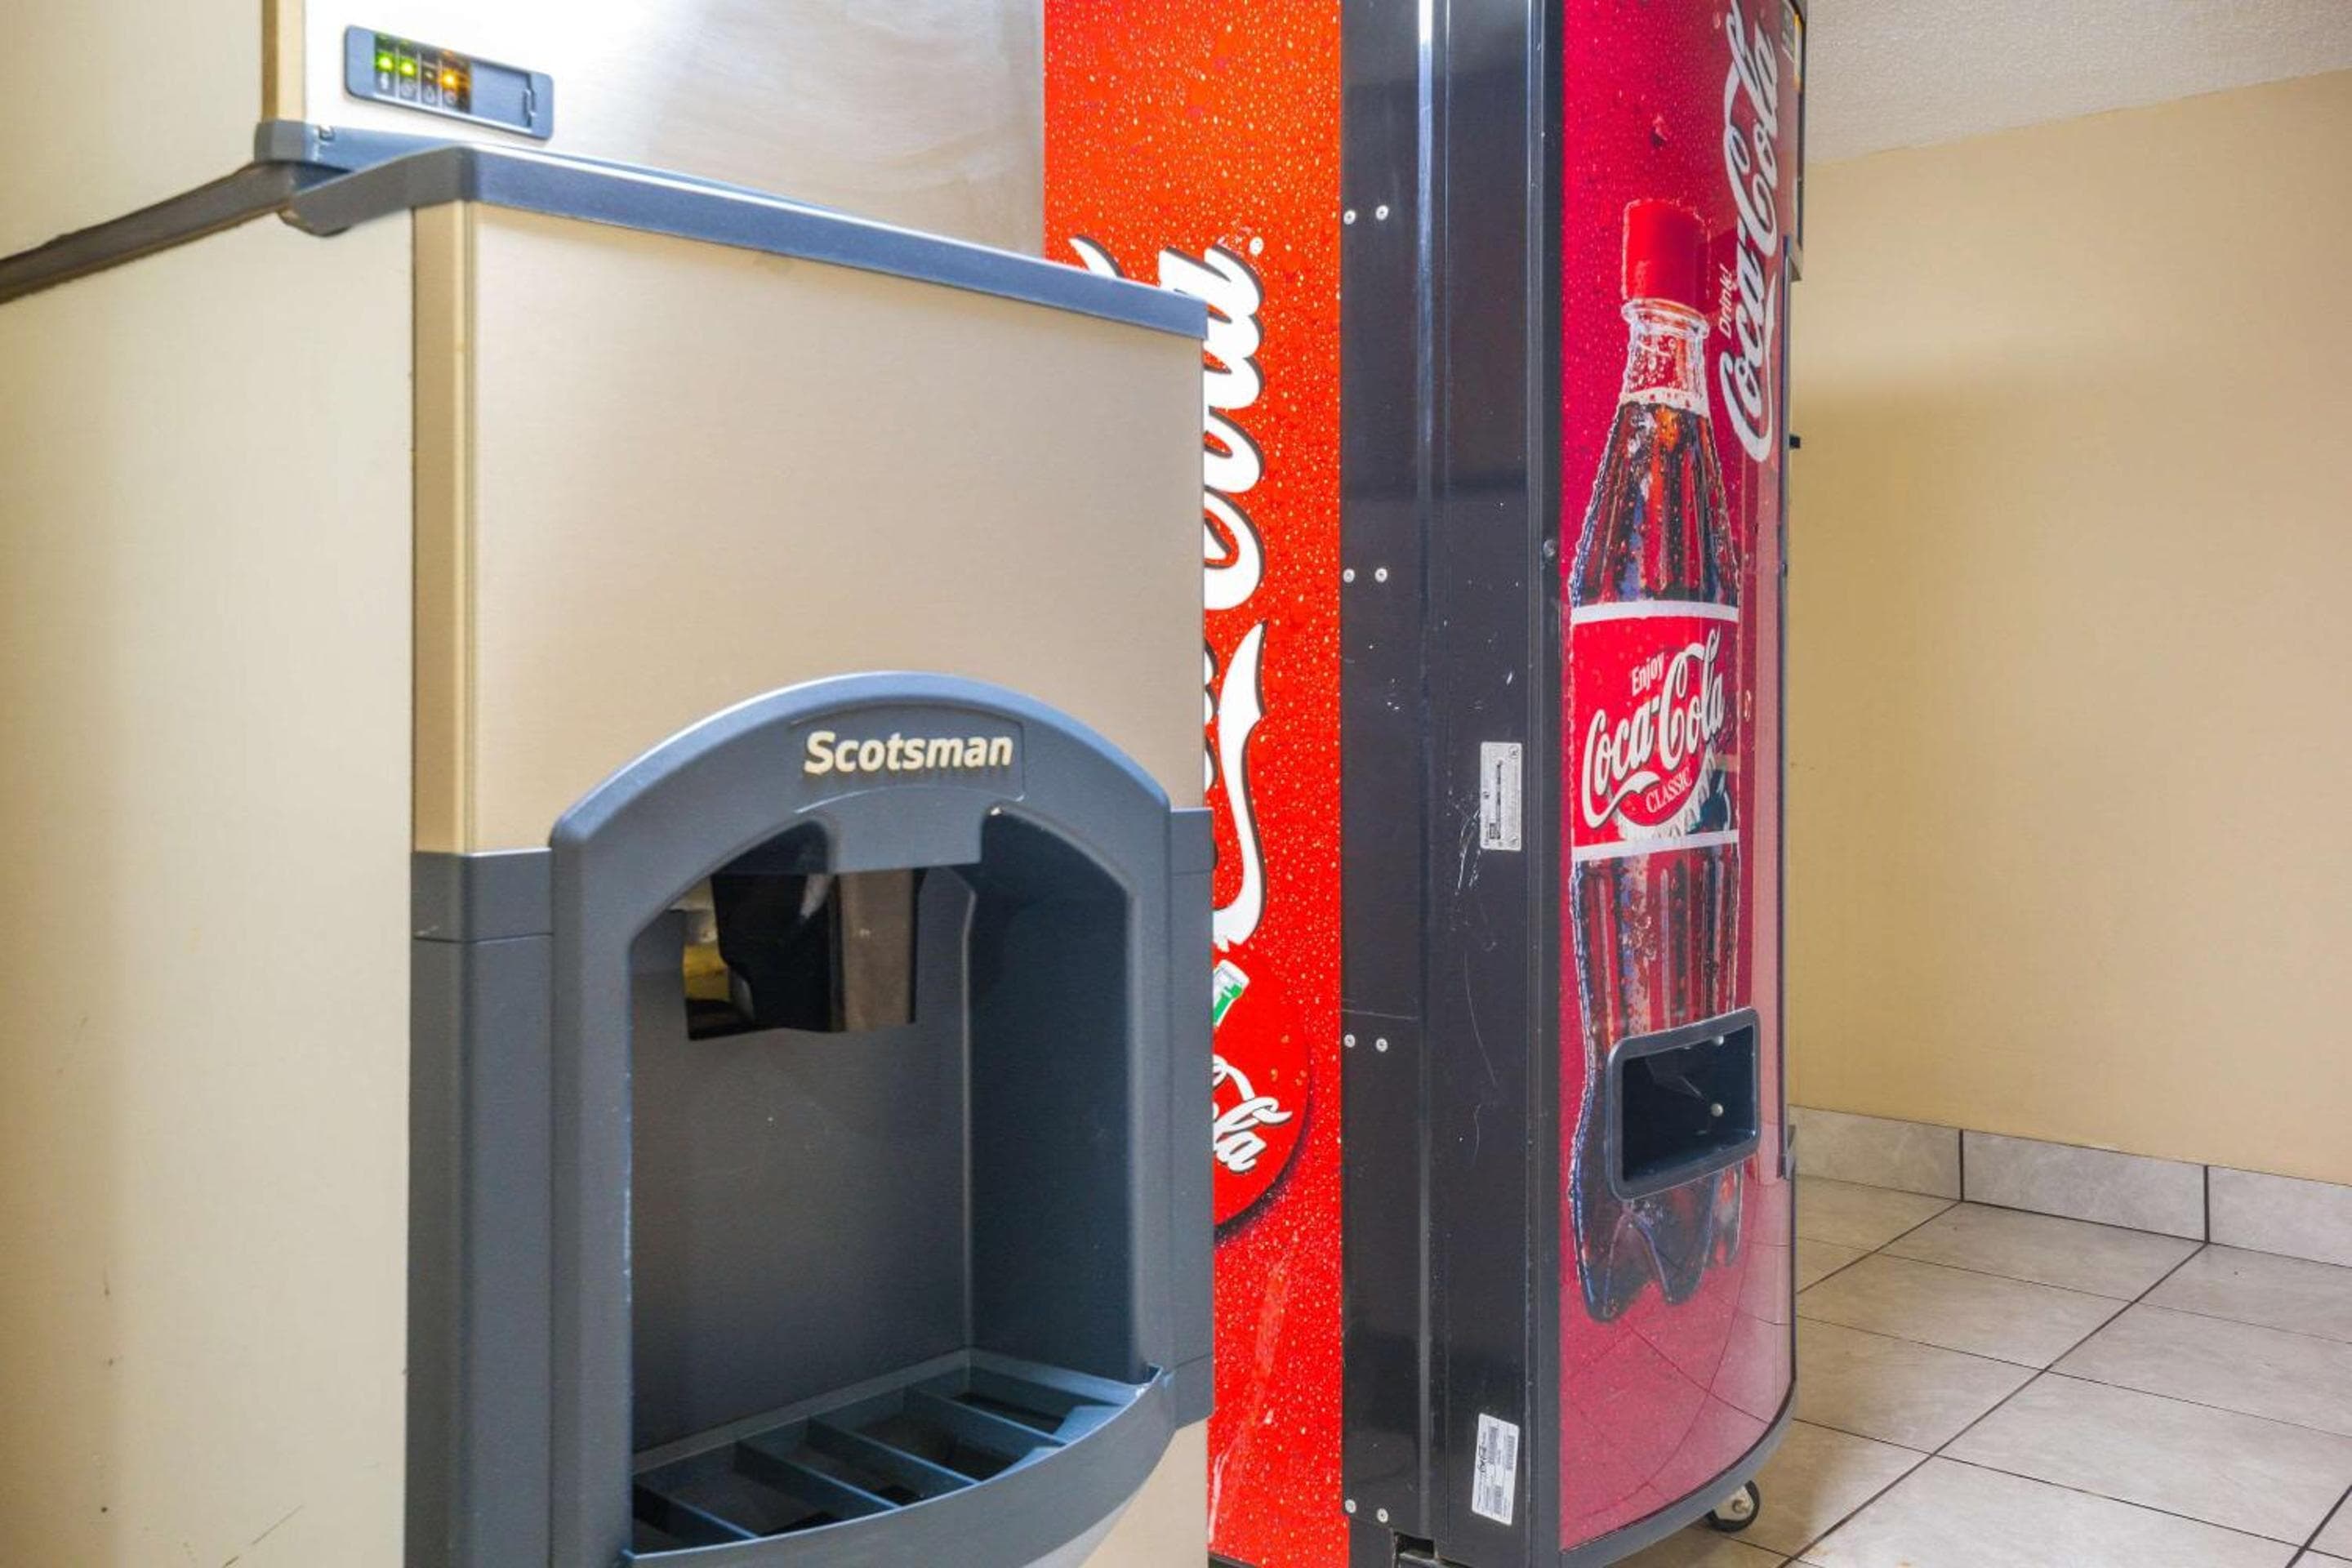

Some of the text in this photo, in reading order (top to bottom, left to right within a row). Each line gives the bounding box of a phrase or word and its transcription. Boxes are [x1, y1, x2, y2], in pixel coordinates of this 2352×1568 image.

[1632, 652, 1665, 697] Enjoy
[1582, 624, 1724, 829] Coca-Cola
[804, 730, 1013, 774] Scotsman
[1646, 768, 1693, 813] CLASSIC
